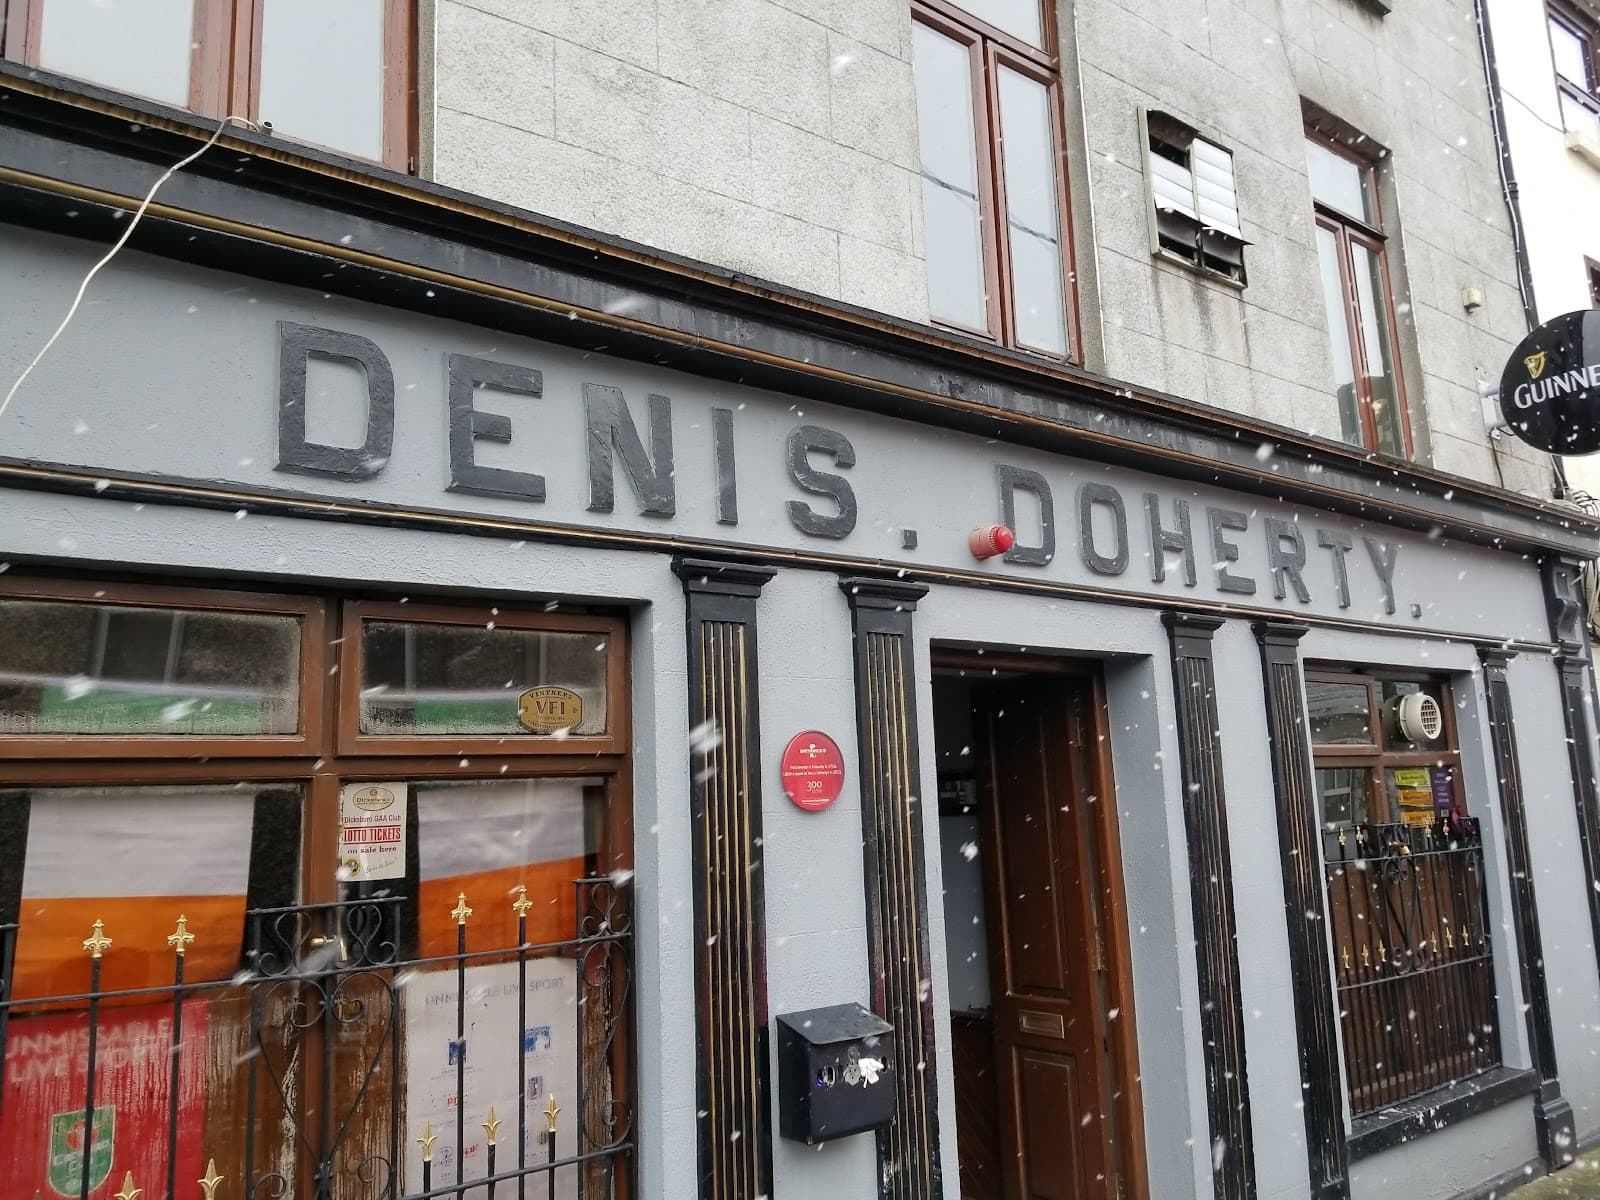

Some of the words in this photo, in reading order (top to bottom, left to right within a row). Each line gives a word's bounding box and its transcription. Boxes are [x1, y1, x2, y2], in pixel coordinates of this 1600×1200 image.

[535, 700, 565, 715] VFI
[344, 815, 373, 824] Dicksboro
[388, 814, 401, 822] Club
[344, 829, 367, 842] LOTTO
[370, 827, 401, 841] TICKETS
[360, 846, 377, 854] sale
[8, 1053, 70, 1083] LIVE
